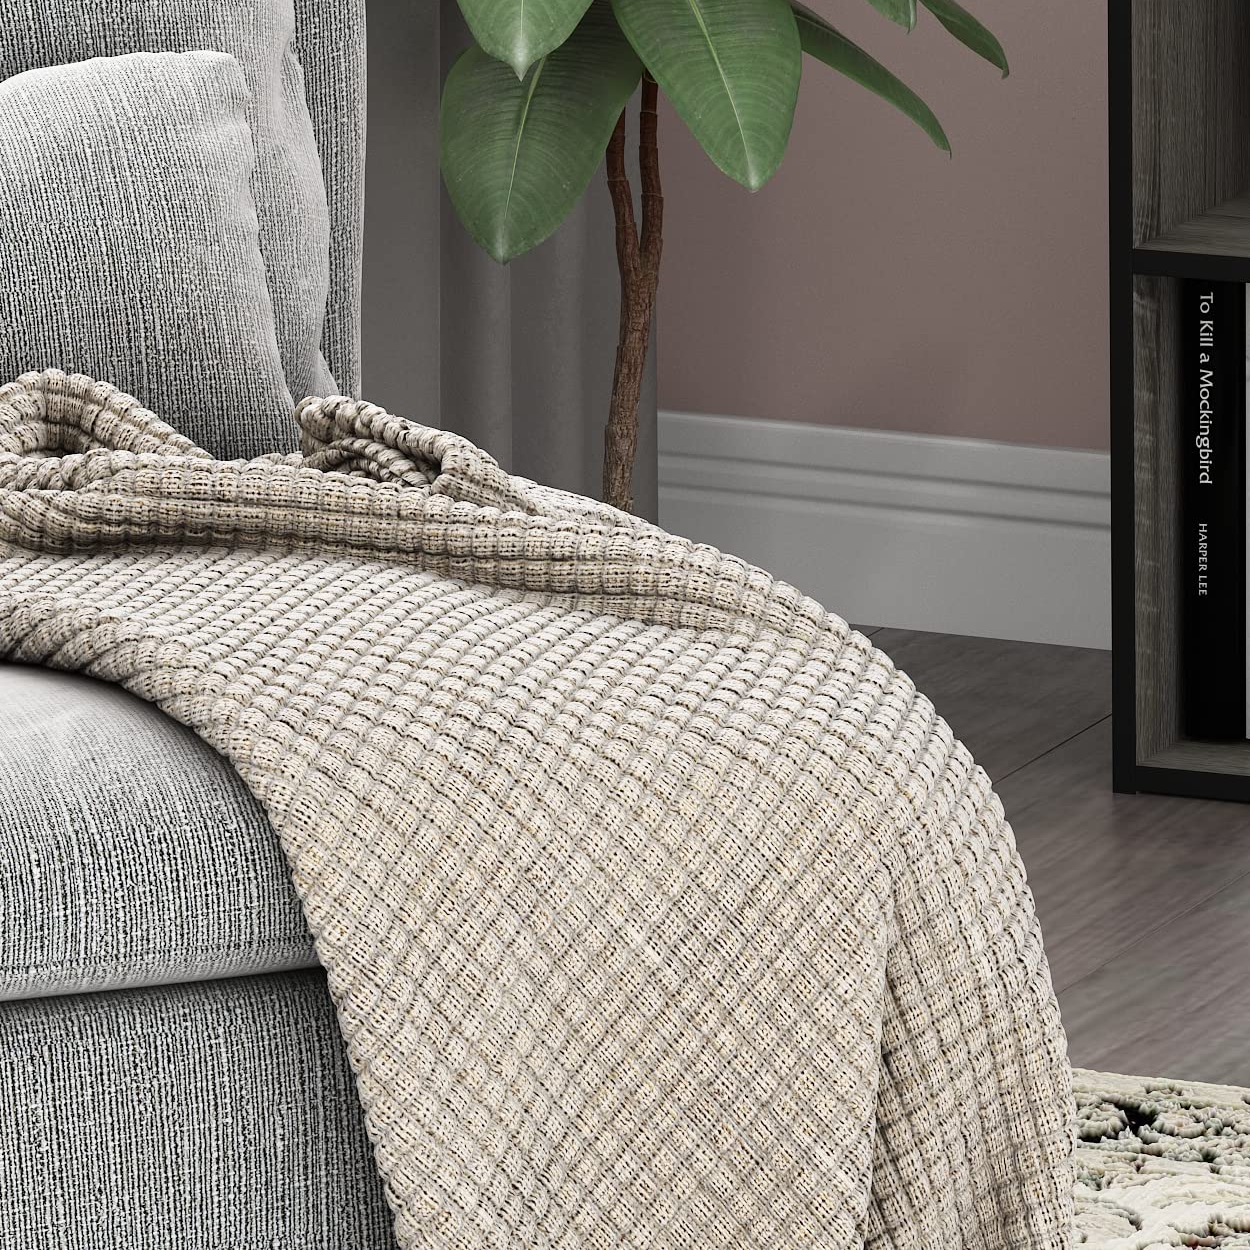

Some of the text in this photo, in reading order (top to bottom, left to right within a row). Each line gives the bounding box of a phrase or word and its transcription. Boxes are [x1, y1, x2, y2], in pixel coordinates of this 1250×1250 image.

[1195, 292, 1214, 484] To Kill a Mockingbird
[1198, 523, 1208, 596] HARPER LEE
